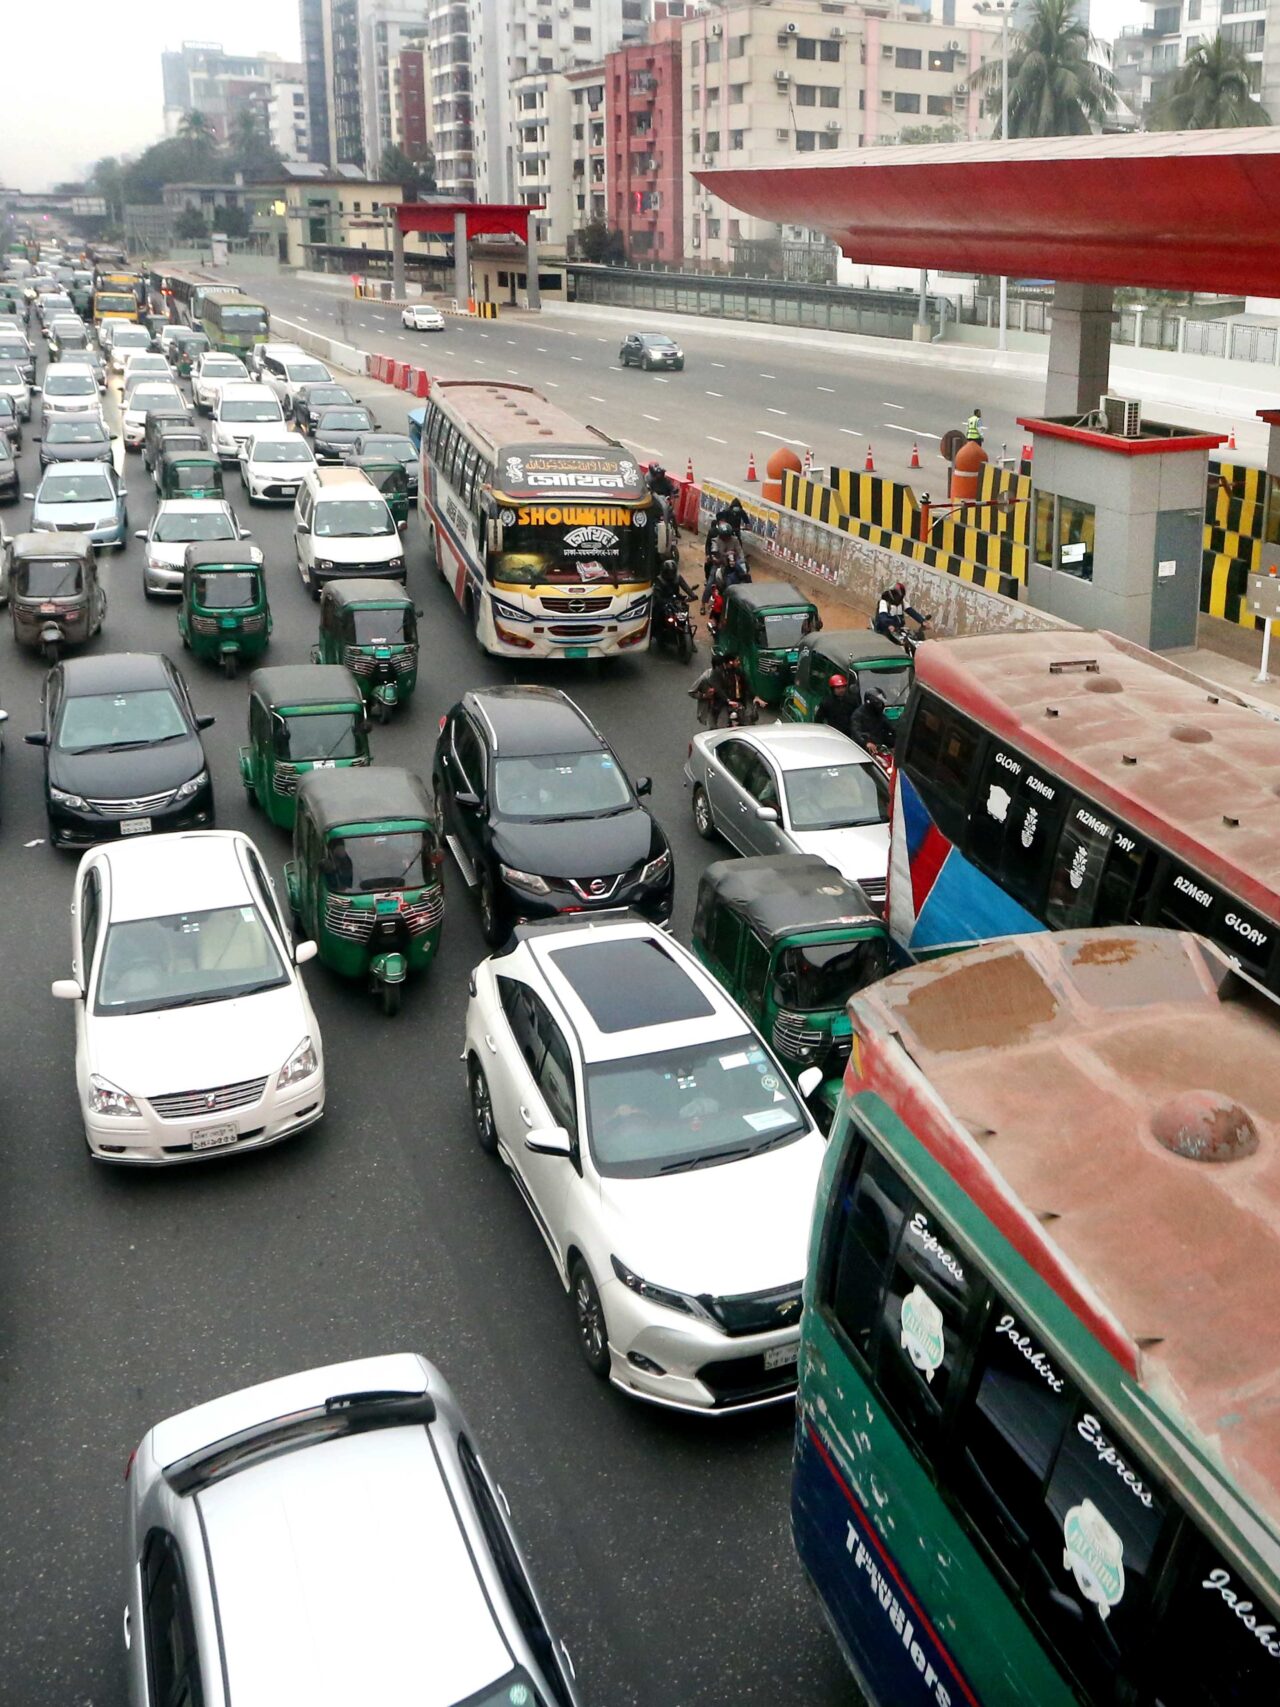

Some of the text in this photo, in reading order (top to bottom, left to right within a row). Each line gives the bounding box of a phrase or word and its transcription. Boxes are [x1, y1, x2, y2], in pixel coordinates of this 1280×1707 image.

[995, 752, 1022, 775] GLORY
[1025, 775, 1056, 800] AZMERI
[1076, 808, 1109, 837] AZMERI
[1173, 875, 1268, 947] AZMERI GLORY
[909, 1212, 966, 1282] Express
[995, 1314, 1064, 1393] Jalshiri
[1077, 1413, 1154, 1508] Express
